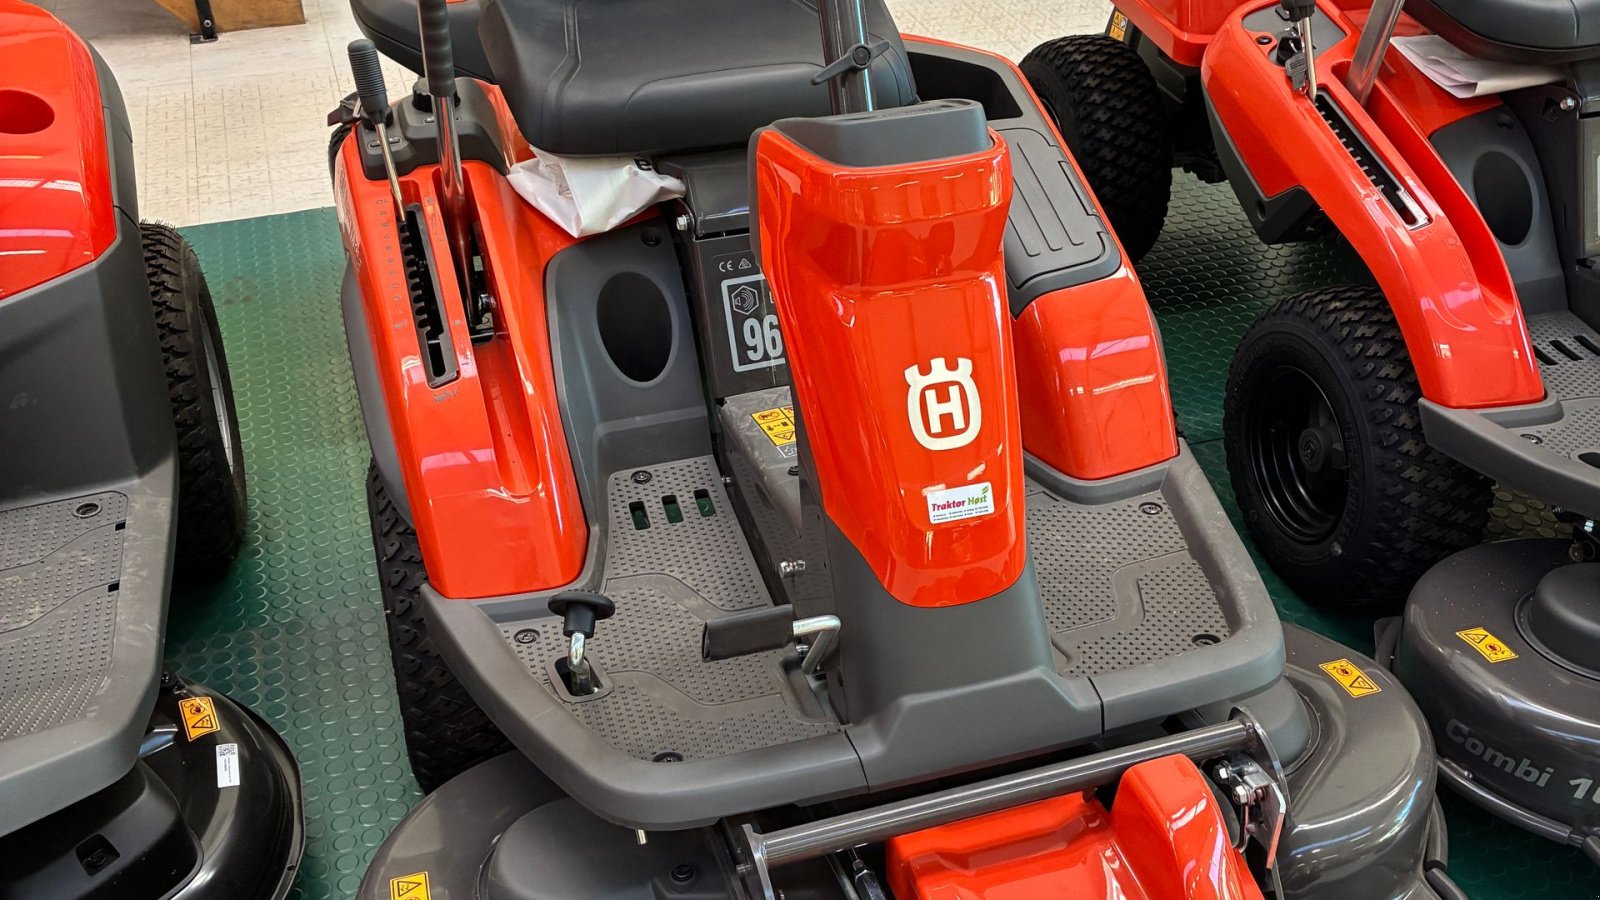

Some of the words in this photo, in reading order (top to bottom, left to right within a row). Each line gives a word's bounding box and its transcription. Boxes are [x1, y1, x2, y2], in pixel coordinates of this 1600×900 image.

[743, 314, 783, 361] 96
[925, 385, 965, 434] H
[931, 499, 966, 512] Traktor
[967, 494, 987, 506] Høst
[1446, 719, 1555, 787] Combi
